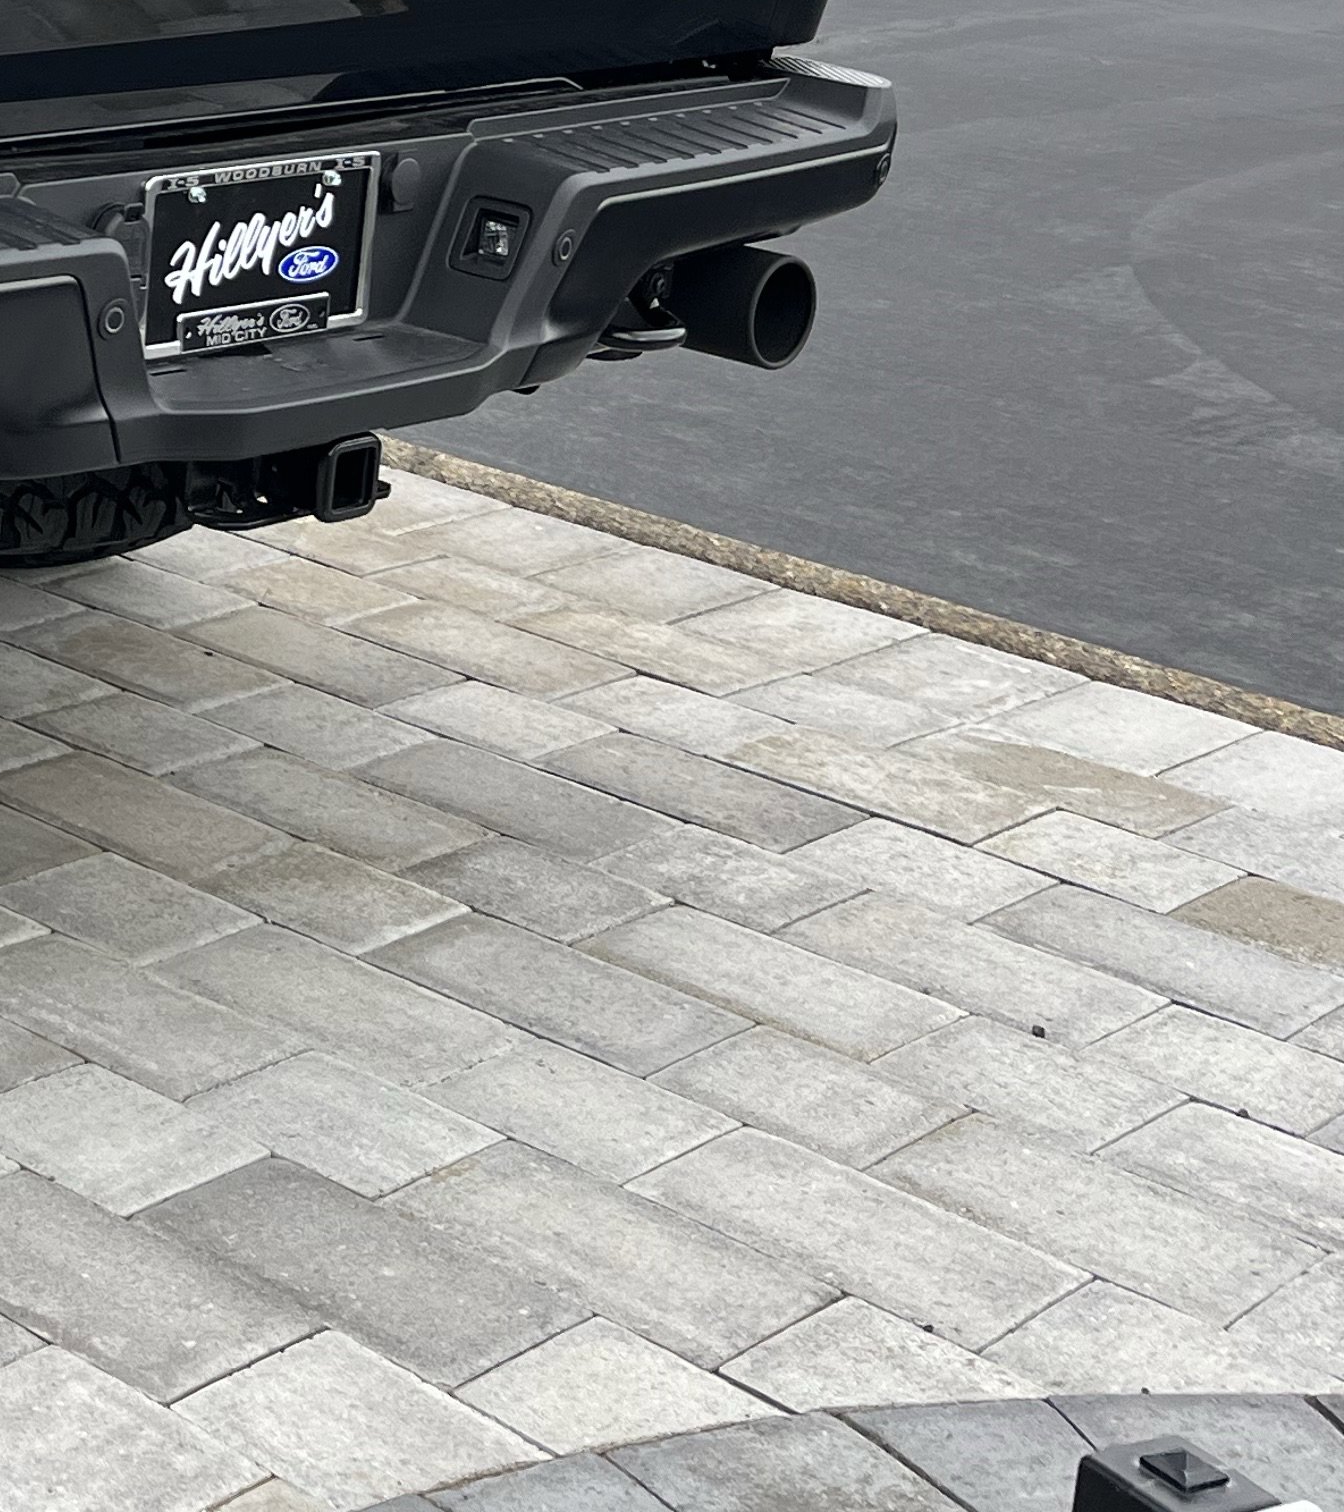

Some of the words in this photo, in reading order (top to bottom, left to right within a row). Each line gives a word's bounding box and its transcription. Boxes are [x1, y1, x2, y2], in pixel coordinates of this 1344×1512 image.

[167, 176, 200, 189] I-5
[214, 161, 323, 184] WOODBURN
[333, 156, 366, 170] I-5
[164, 183, 335, 304] Hillyer's
[288, 250, 328, 278] Ford
[277, 308, 304, 329] Ford
[206, 333, 231, 346] MID
[234, 327, 267, 342] CITY
